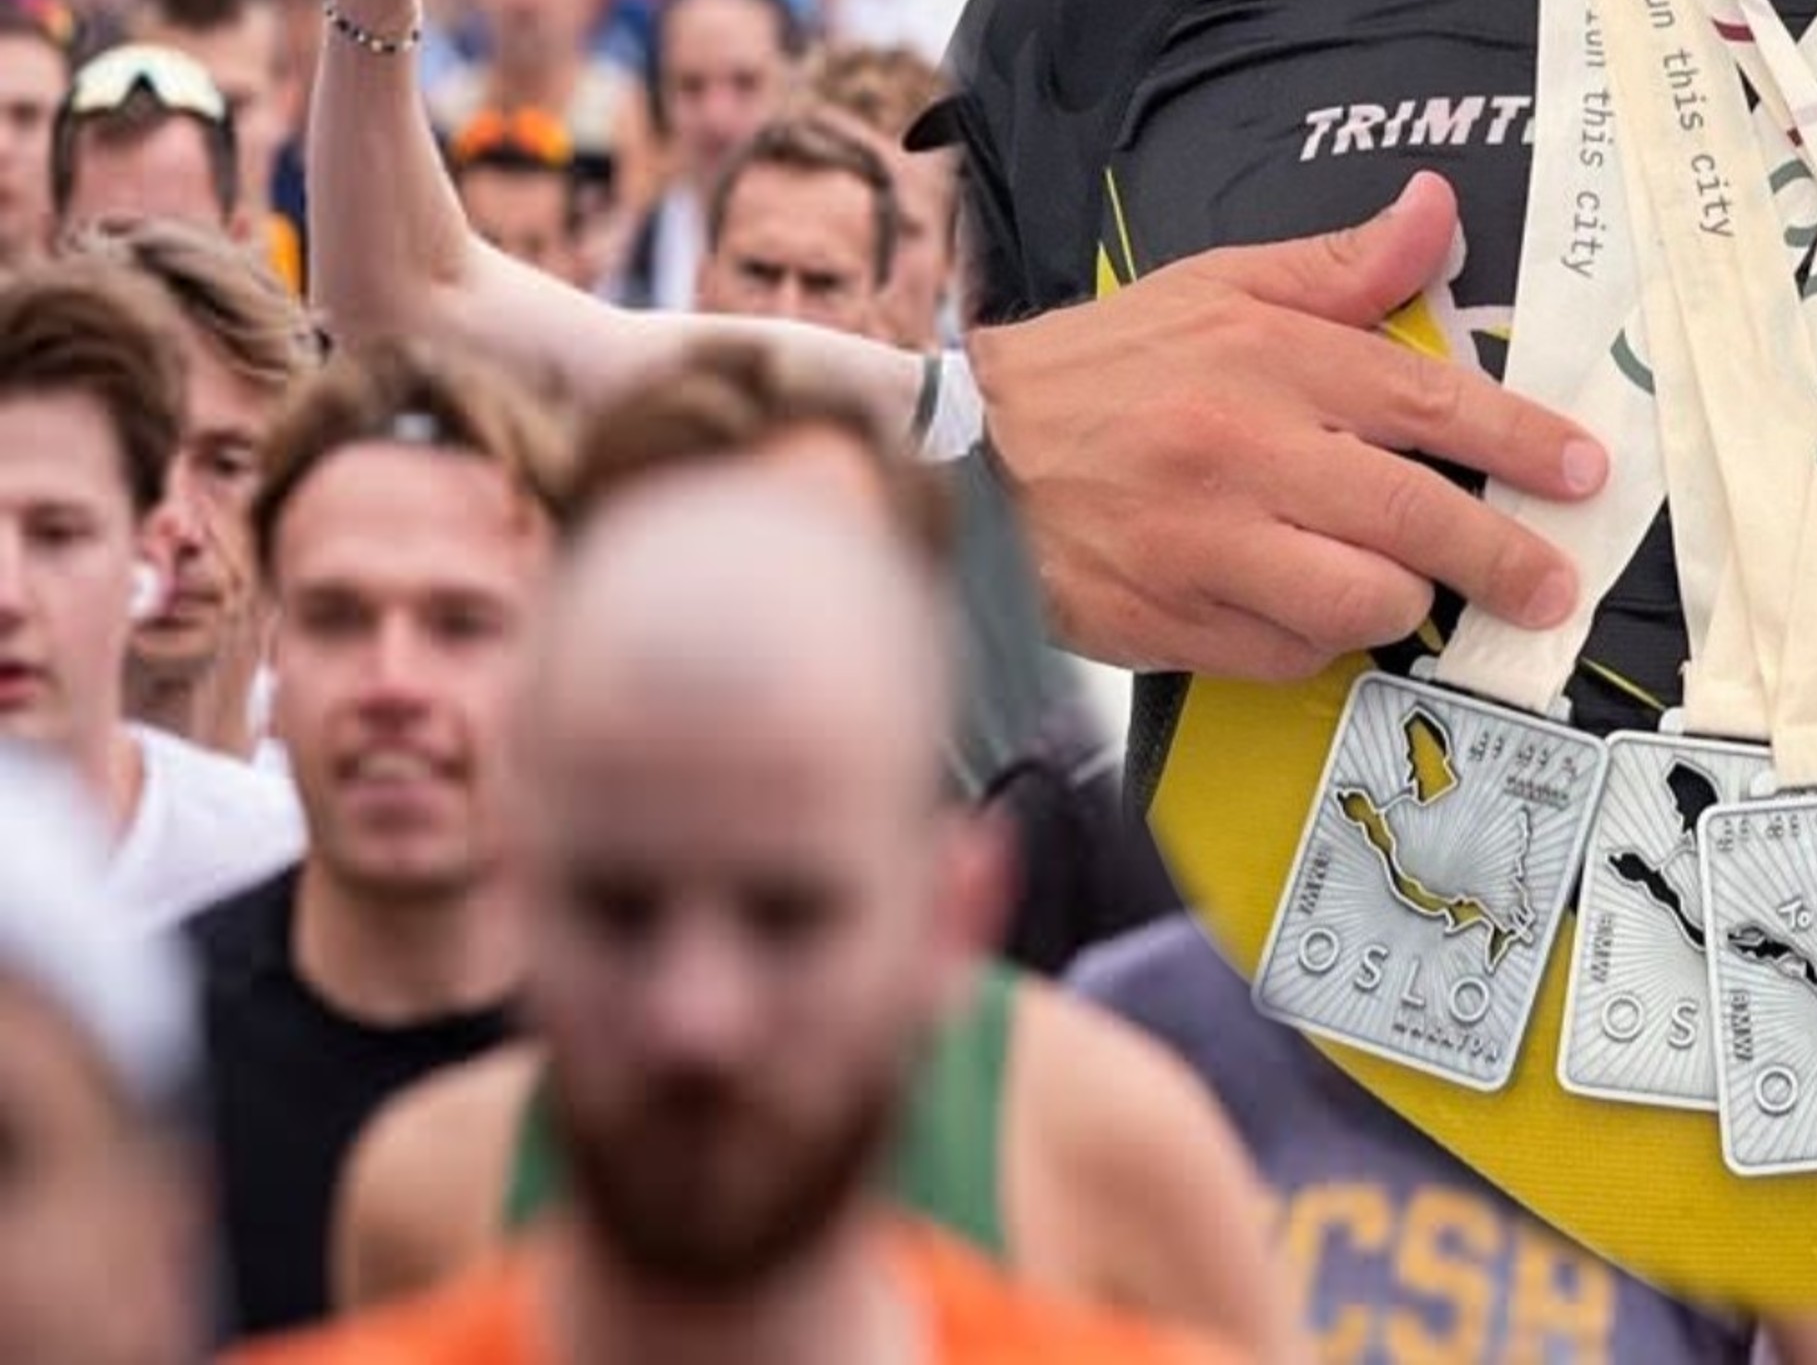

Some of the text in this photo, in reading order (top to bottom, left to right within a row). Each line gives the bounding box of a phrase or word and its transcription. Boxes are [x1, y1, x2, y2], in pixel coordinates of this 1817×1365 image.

[1581, 90, 1616, 170] this
[1661, 47, 1704, 133] this
[1689, 152, 1735, 239] city
[1560, 190, 1602, 280] city
[1299, 926, 1490, 1025] OSLO
